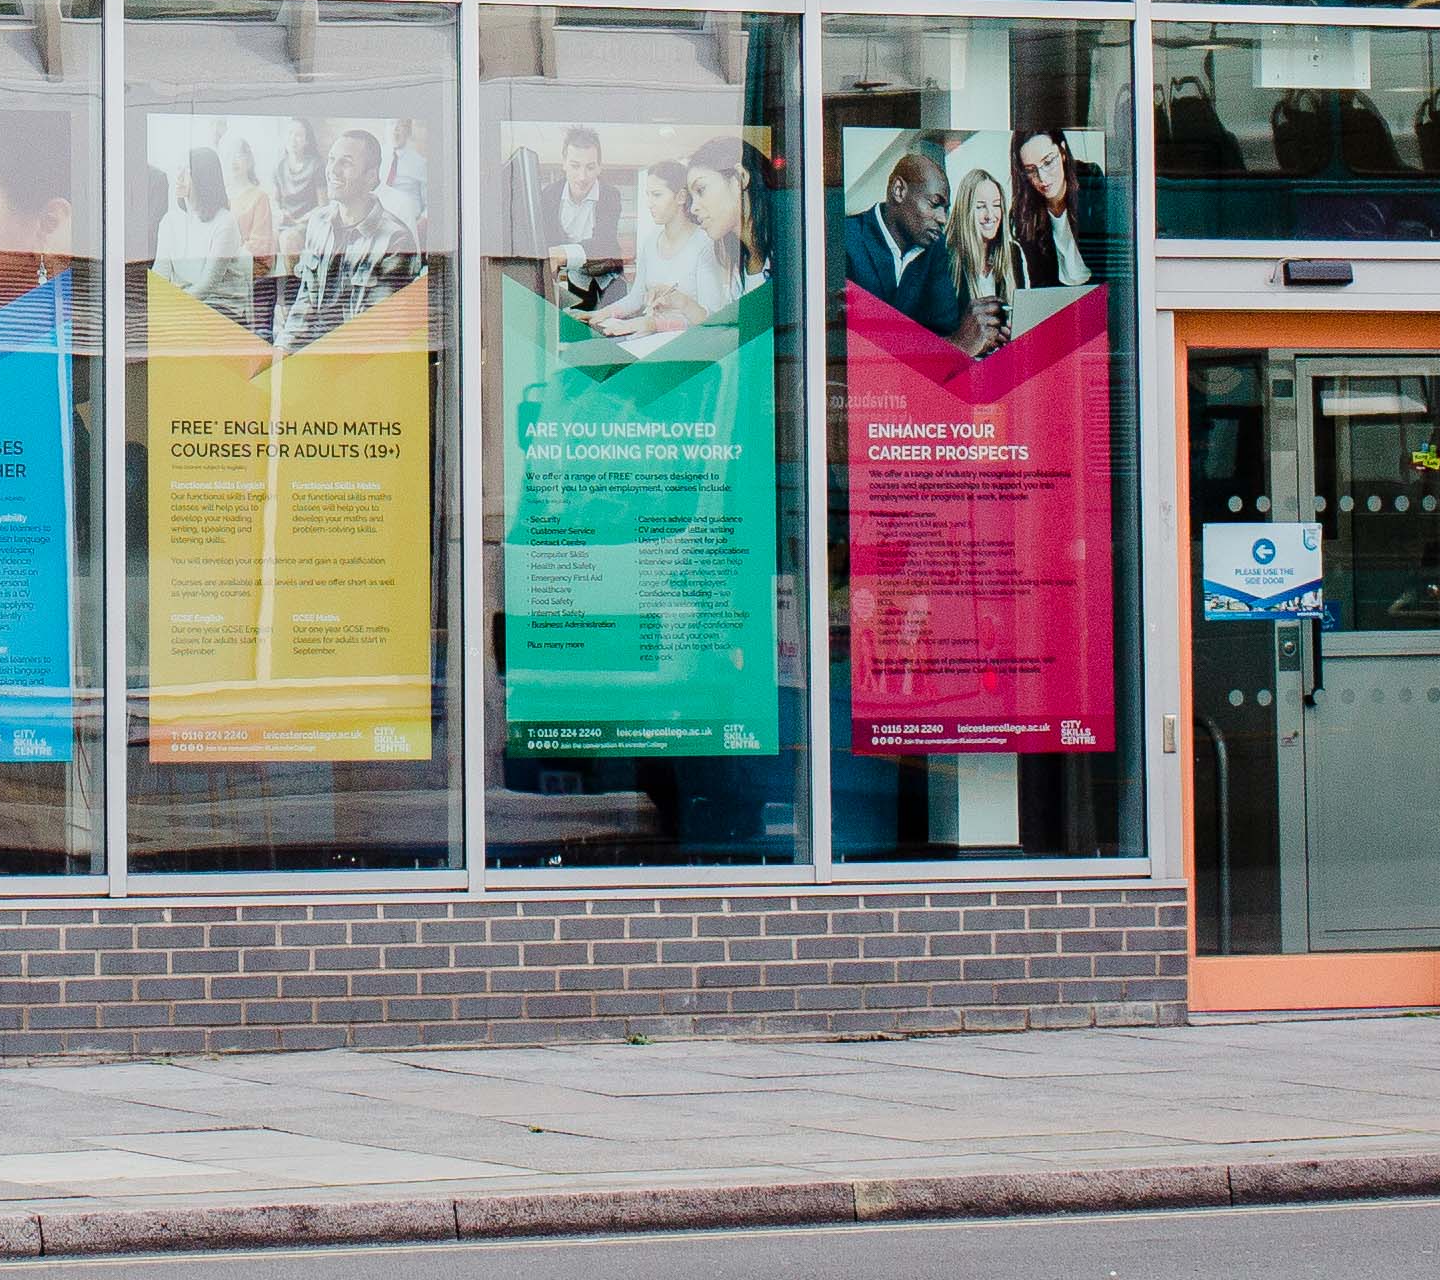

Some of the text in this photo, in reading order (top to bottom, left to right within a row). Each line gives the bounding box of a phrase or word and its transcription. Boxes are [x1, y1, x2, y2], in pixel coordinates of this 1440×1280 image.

[224, 421, 297, 435] ENGLISH
[302, 422, 338, 435] AND
[343, 422, 402, 436] MATHS
[526, 423, 717, 438] ARE YOU UNEMPLOYED
[868, 424, 994, 438] ENHANCE YOUR
[171, 444, 400, 459] COURSES FOR ADULTS (19+)
[526, 444, 742, 460] AND LOOKING FOR WORK?
[868, 446, 1029, 460] CAREER PROSPECTS
[526, 472, 540, 481] We
[543, 472, 561, 481] offer
[571, 473, 596, 482] range
[598, 472, 607, 480] of
[671, 472, 709, 482] designed
[881, 725, 901, 733] 0116
[903, 725, 919, 733] 224
[922, 725, 943, 733] 2240
[1061, 720, 1081, 728] CITY
[538, 729, 558, 738] 0116
[561, 729, 576, 738] 224
[579, 728, 601, 737] 2240
[724, 732, 755, 741] SKILLS
[1061, 728, 1091, 736] SKILLS
[724, 740, 760, 749] CENTRE
[1061, 736, 1096, 744] CENTRE
